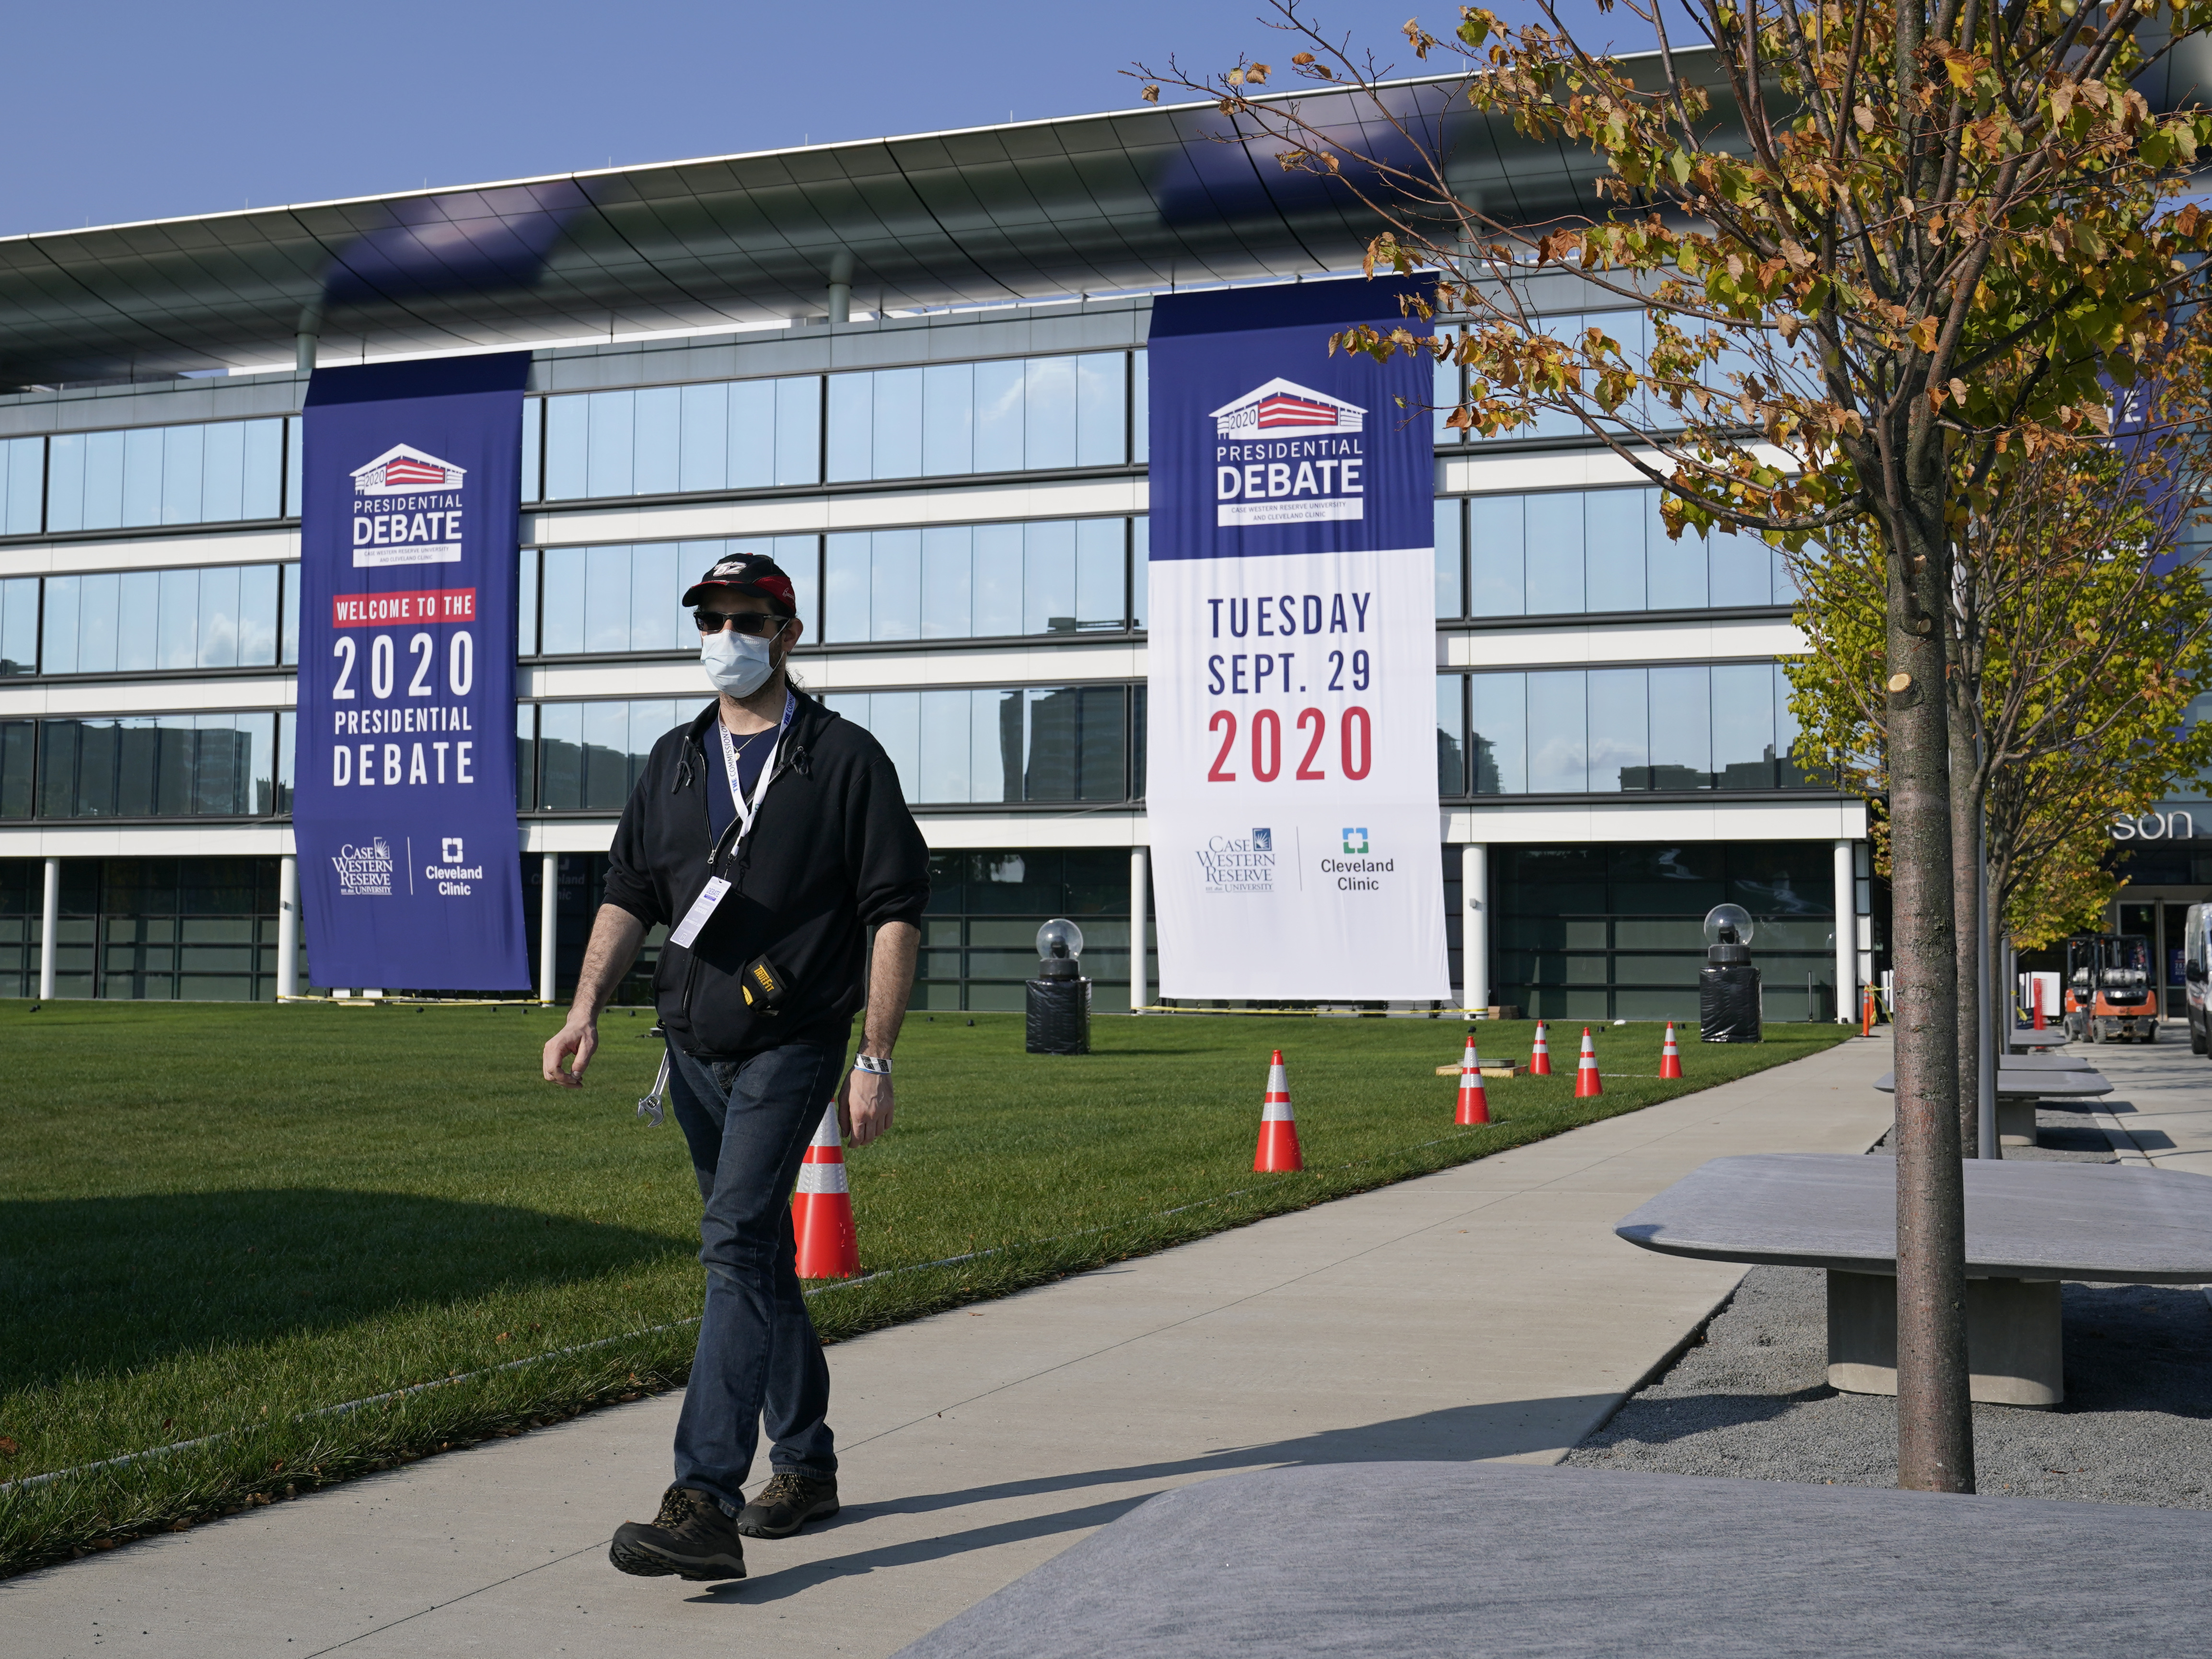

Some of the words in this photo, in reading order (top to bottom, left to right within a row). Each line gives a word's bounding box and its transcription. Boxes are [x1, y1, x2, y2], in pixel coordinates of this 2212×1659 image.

[1231, 409, 1256, 429] 2020
[1217, 439, 1363, 462] PRESIDENTIAL
[366, 470, 384, 487] 2020
[1217, 459, 1364, 500] DEBATE
[354, 494, 462, 513] PRESIDENTIAL
[1309, 501, 1346, 509] UNIVERSITY
[353, 510, 462, 545] DEBATE
[337, 598, 409, 620] WELCOME
[417, 597, 435, 616] TO
[444, 595, 472, 615] THE
[1208, 592, 1370, 638] TUESDAY
[333, 631, 473, 699] 2020
[1208, 653, 1306, 695] SEPT.
[1328, 650, 1369, 691] 29
[335, 707, 472, 734] PRESIDENTIAL
[1208, 706, 1371, 782] 2020
[334, 741, 474, 786] DEBATE
[724, 734, 736, 777] COMMISSION
[341, 844, 374, 859] CASE
[1209, 836, 1251, 853] CASE
[331, 857, 393, 872] WESTERN
[1195, 851, 1275, 866] WESTERN
[1321, 859, 1394, 872] Cleveland
[340, 871, 391, 888] RESERVE
[426, 866, 482, 879] Cleveland
[1206, 866, 1272, 885] RESERVE
[355, 886, 392, 894] UNIVERSITY
[439, 882, 471, 895] Clinic
[1225, 883, 1274, 893] UNIVERSITY
[1338, 877, 1379, 890] Clinic
[753, 964, 775, 992] TRUEFIT
